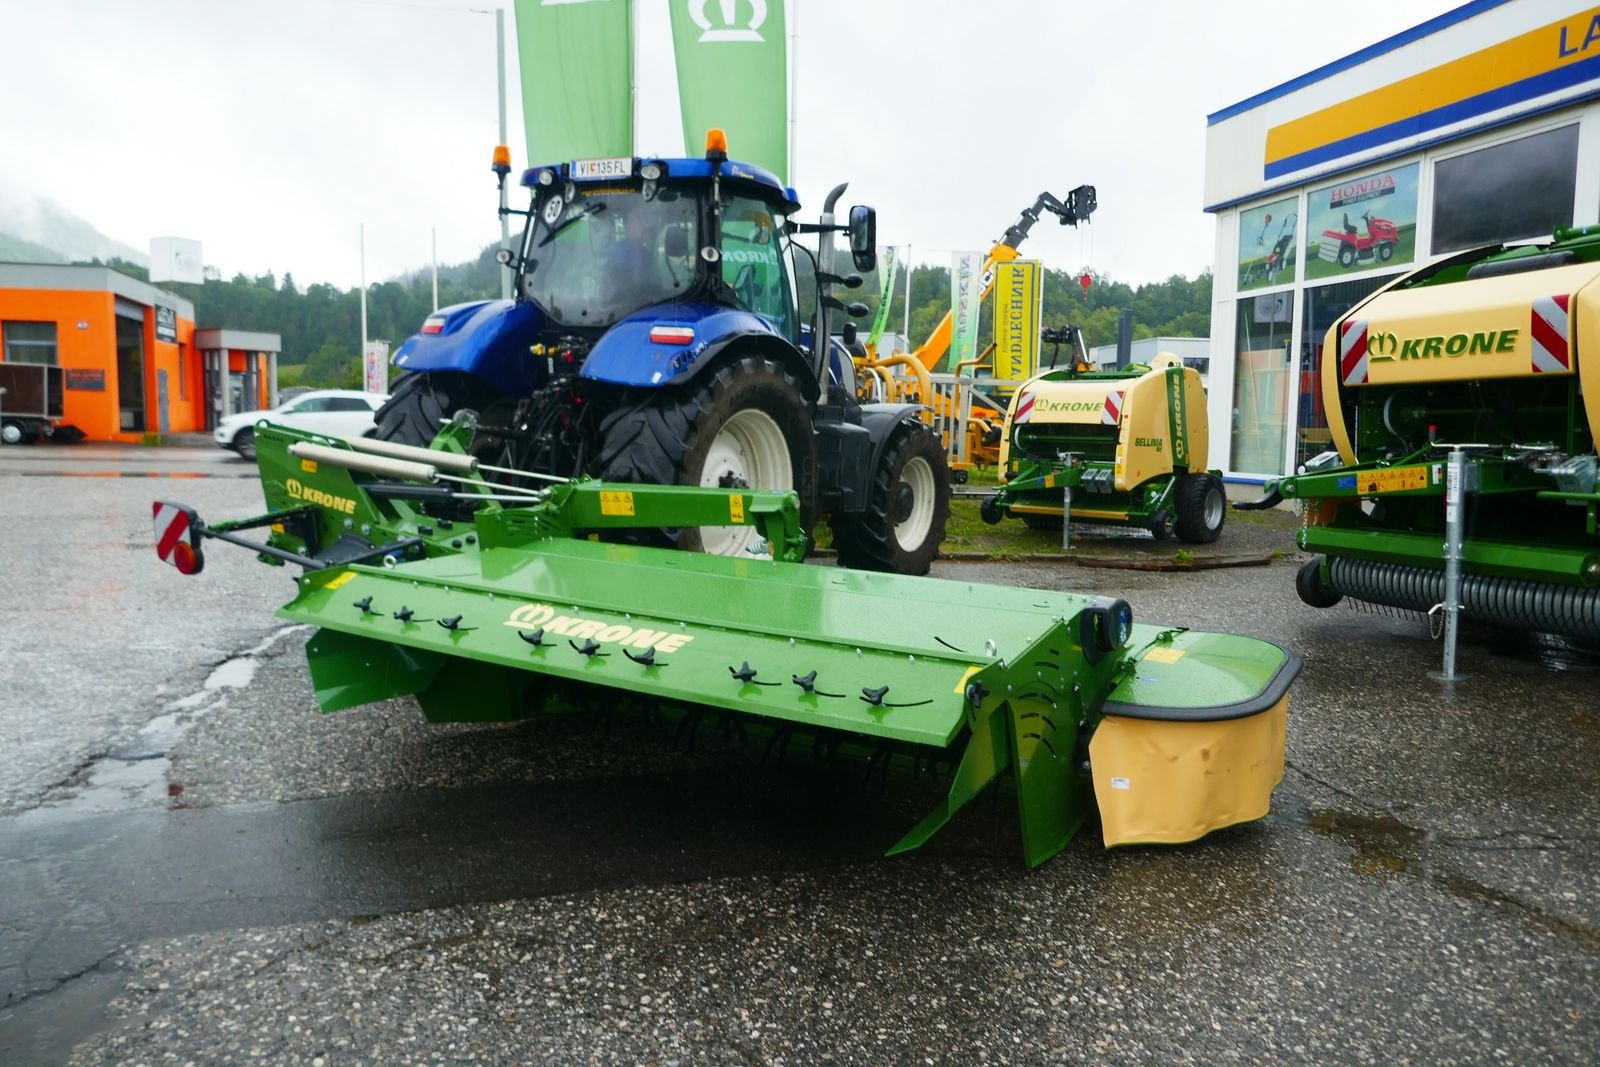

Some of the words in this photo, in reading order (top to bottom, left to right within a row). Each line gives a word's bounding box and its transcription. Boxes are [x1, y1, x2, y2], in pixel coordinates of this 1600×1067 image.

[580, 162, 589, 174] VI
[1330, 175, 1395, 201] HONDA
[547, 200, 561, 217] 50
[1401, 329, 1519, 361] KRONE
[1049, 402, 1103, 412] KRONE
[1173, 374, 1183, 437] KRONE
[303, 486, 357, 515] KRONE
[542, 616, 695, 653] KRONE
